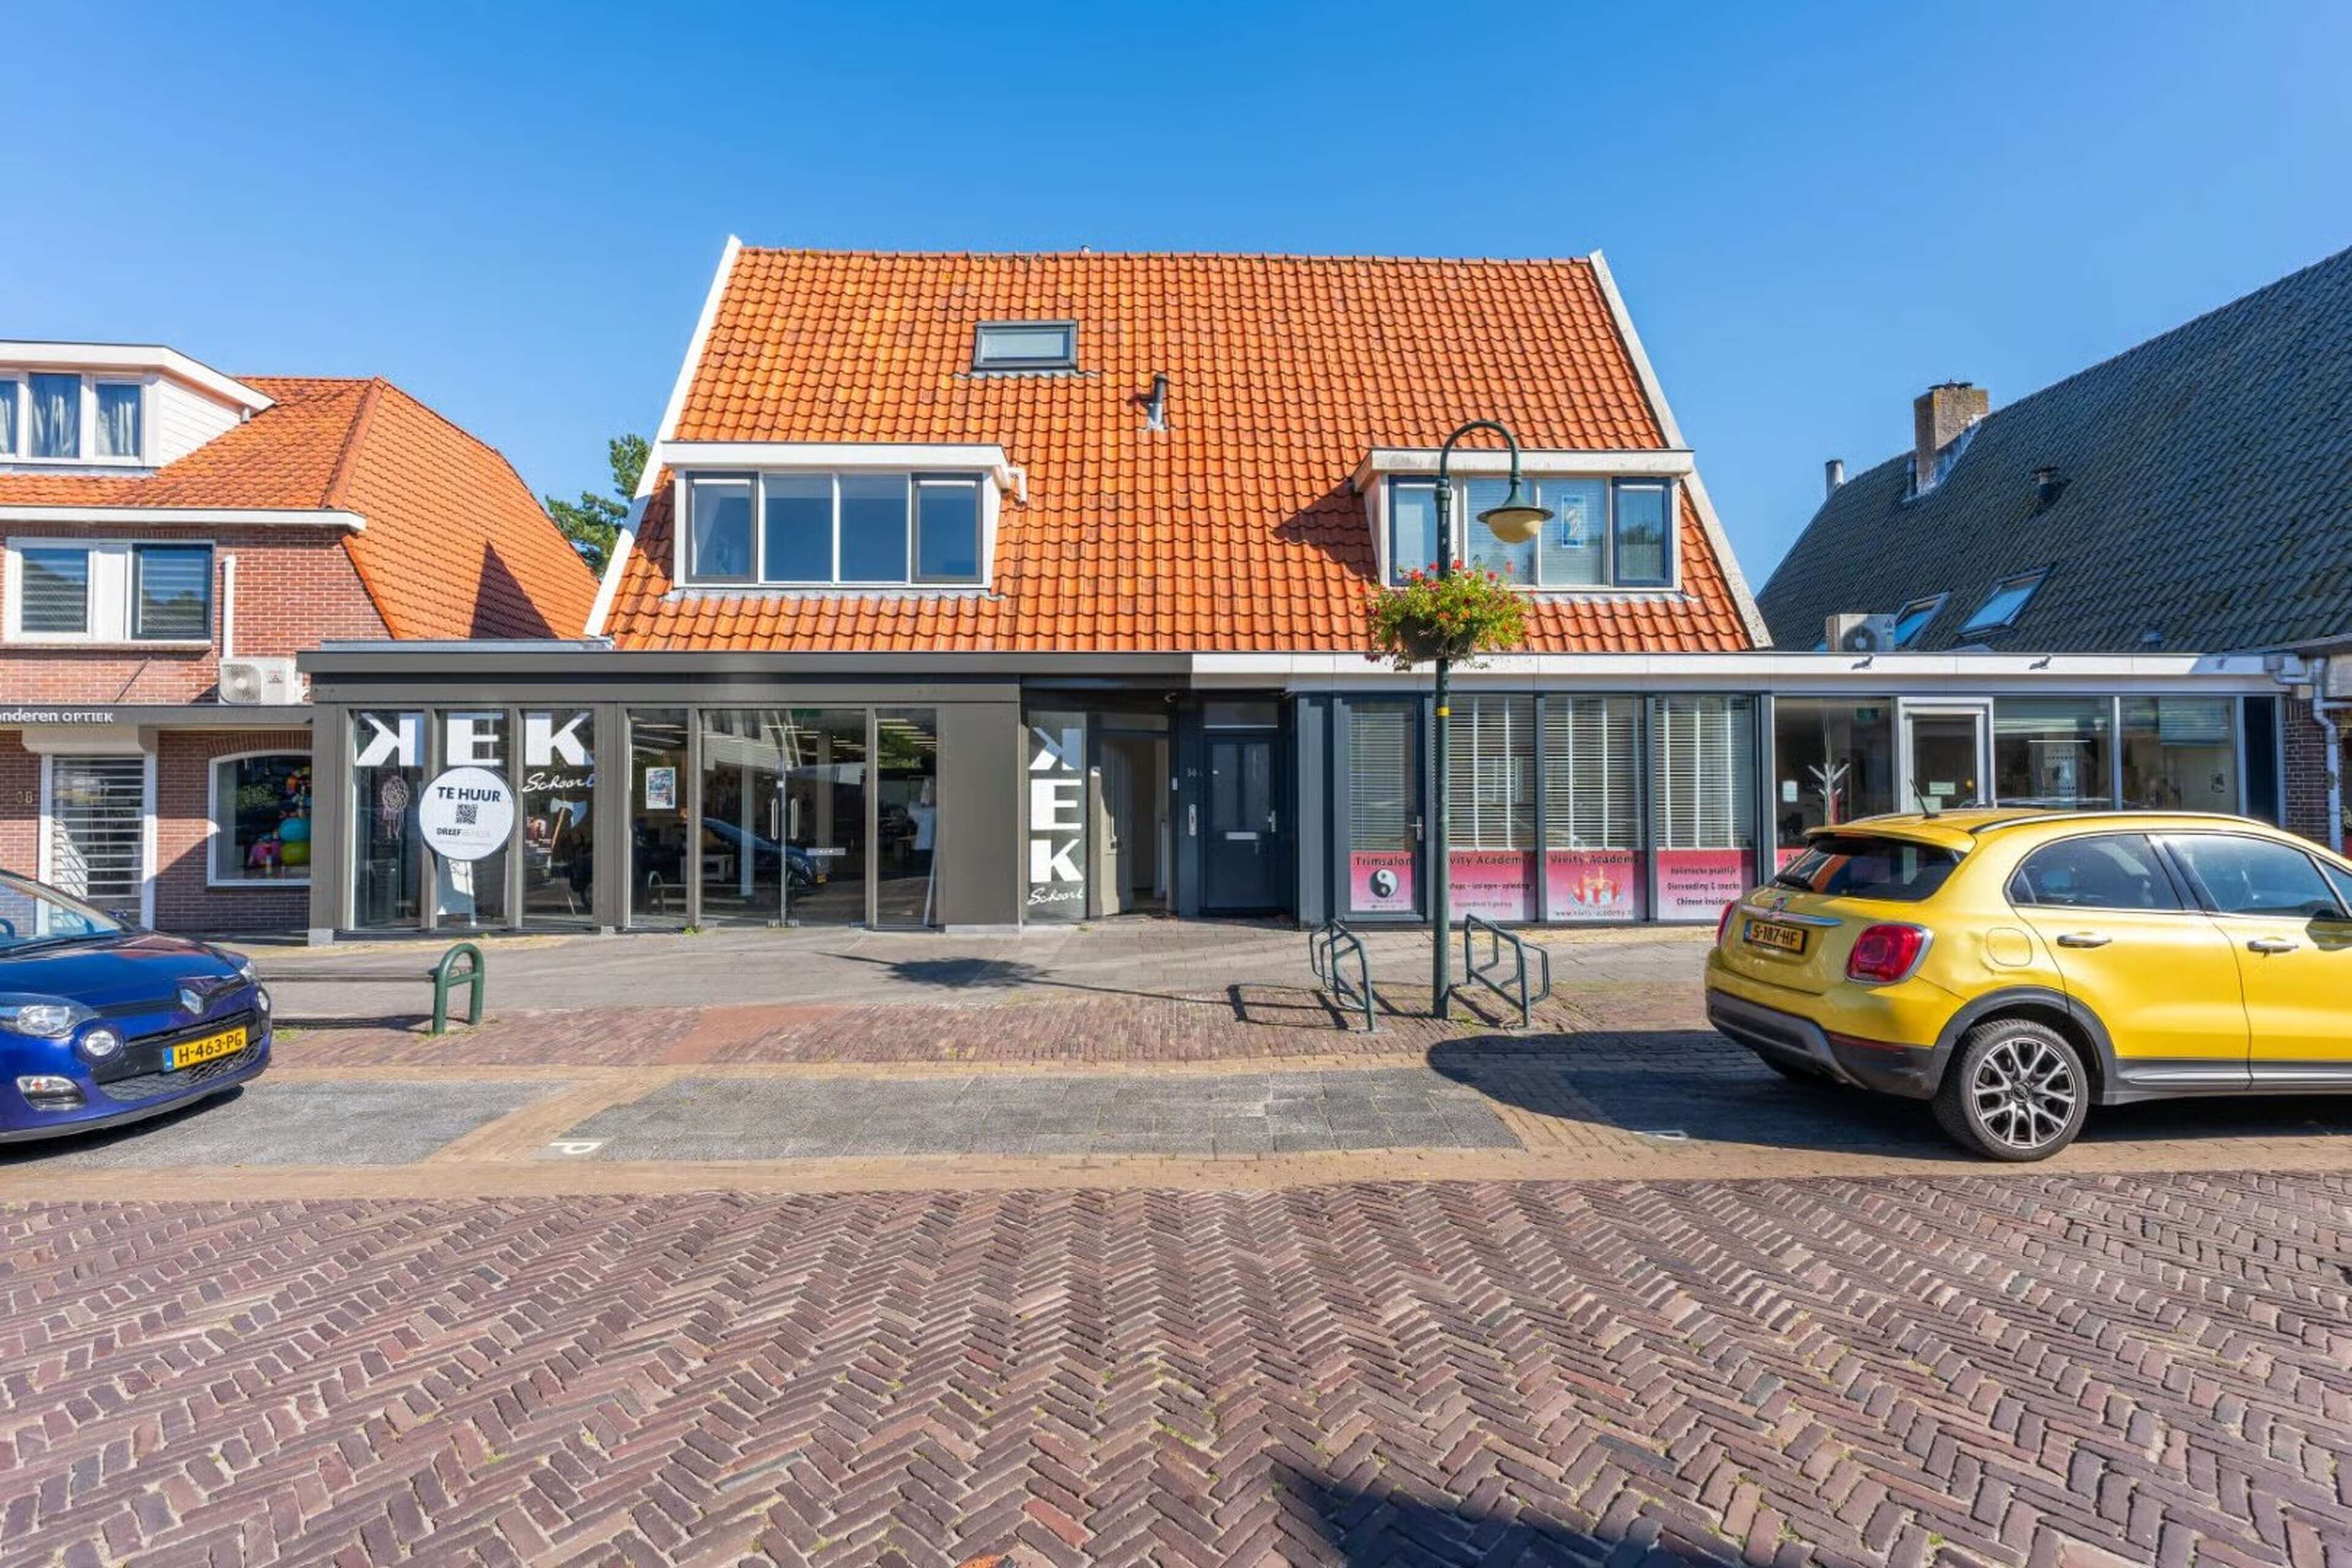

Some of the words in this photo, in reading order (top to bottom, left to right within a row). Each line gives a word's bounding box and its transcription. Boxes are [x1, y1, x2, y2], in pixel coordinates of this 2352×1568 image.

[62, 712, 113, 722] OPTIEK
[437, 786, 455, 799] TE
[459, 788, 500, 802] HUUR
[1355, 856, 1412, 866] Trimsalon
[1450, 857, 1472, 866] vity
[1476, 855, 1529, 865] Academy
[1589, 855, 1638, 867] Academy
[1027, 888, 1083, 905] Schoorl
[179, 1032, 242, 1064] H-463-PG
